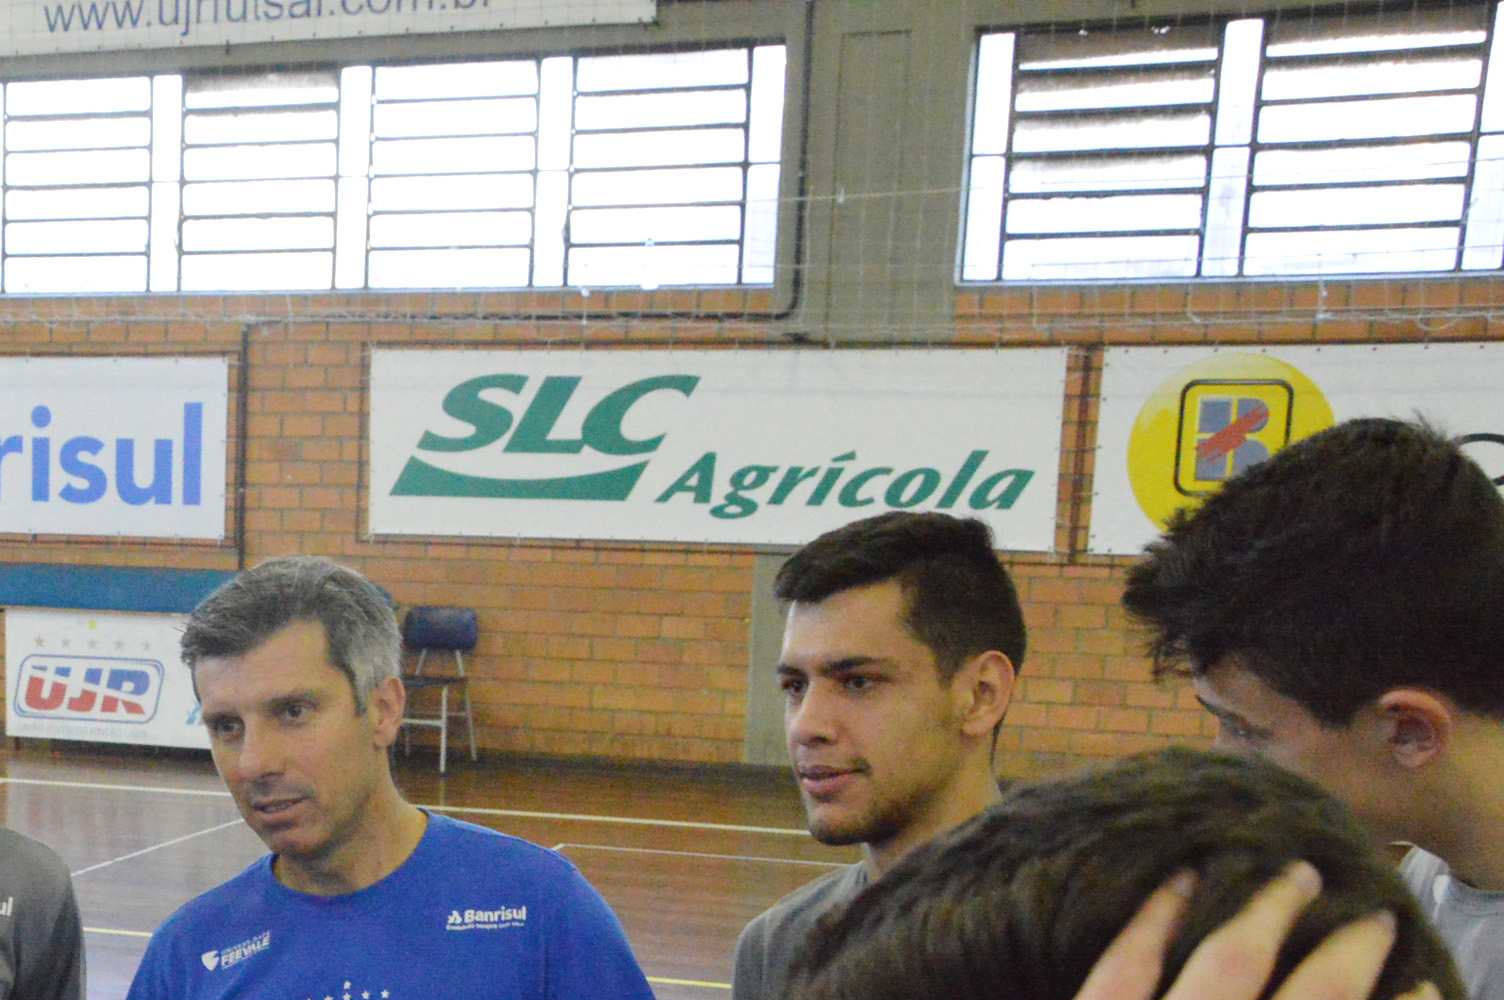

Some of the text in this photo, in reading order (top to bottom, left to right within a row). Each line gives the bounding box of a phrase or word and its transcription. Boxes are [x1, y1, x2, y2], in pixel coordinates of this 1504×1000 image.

[43, 0, 490, 36] www.ujrfutsa.co.
[415, 373, 700, 455] SLC
[654, 450, 1036, 519] Agrícola
[25, 665, 150, 714] UJR
[463, 905, 527, 923] Banrisul
[221, 937, 270, 966] FEEVALE
